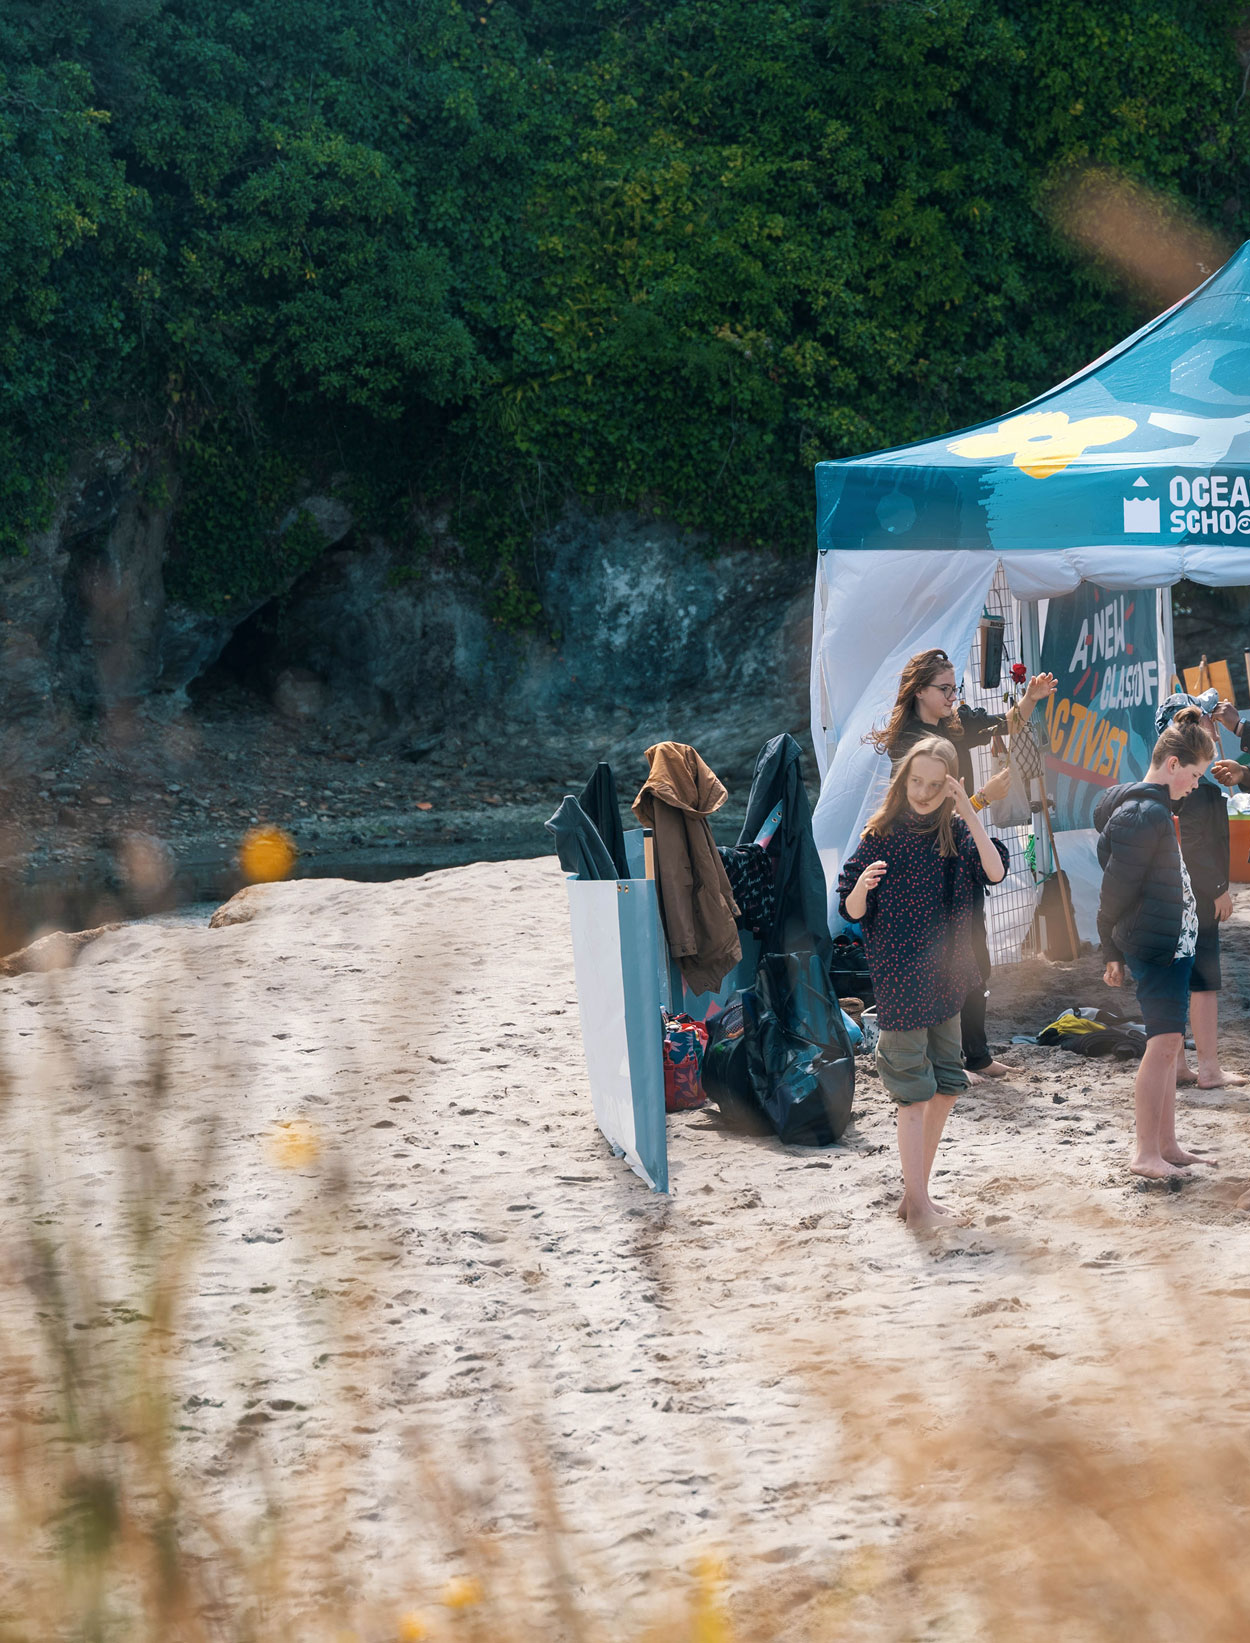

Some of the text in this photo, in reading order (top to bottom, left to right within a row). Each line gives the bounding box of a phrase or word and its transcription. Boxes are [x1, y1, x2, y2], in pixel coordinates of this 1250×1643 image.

[1068, 594, 1126, 673] A NEW
[1099, 660, 1159, 711] CLASS OF
